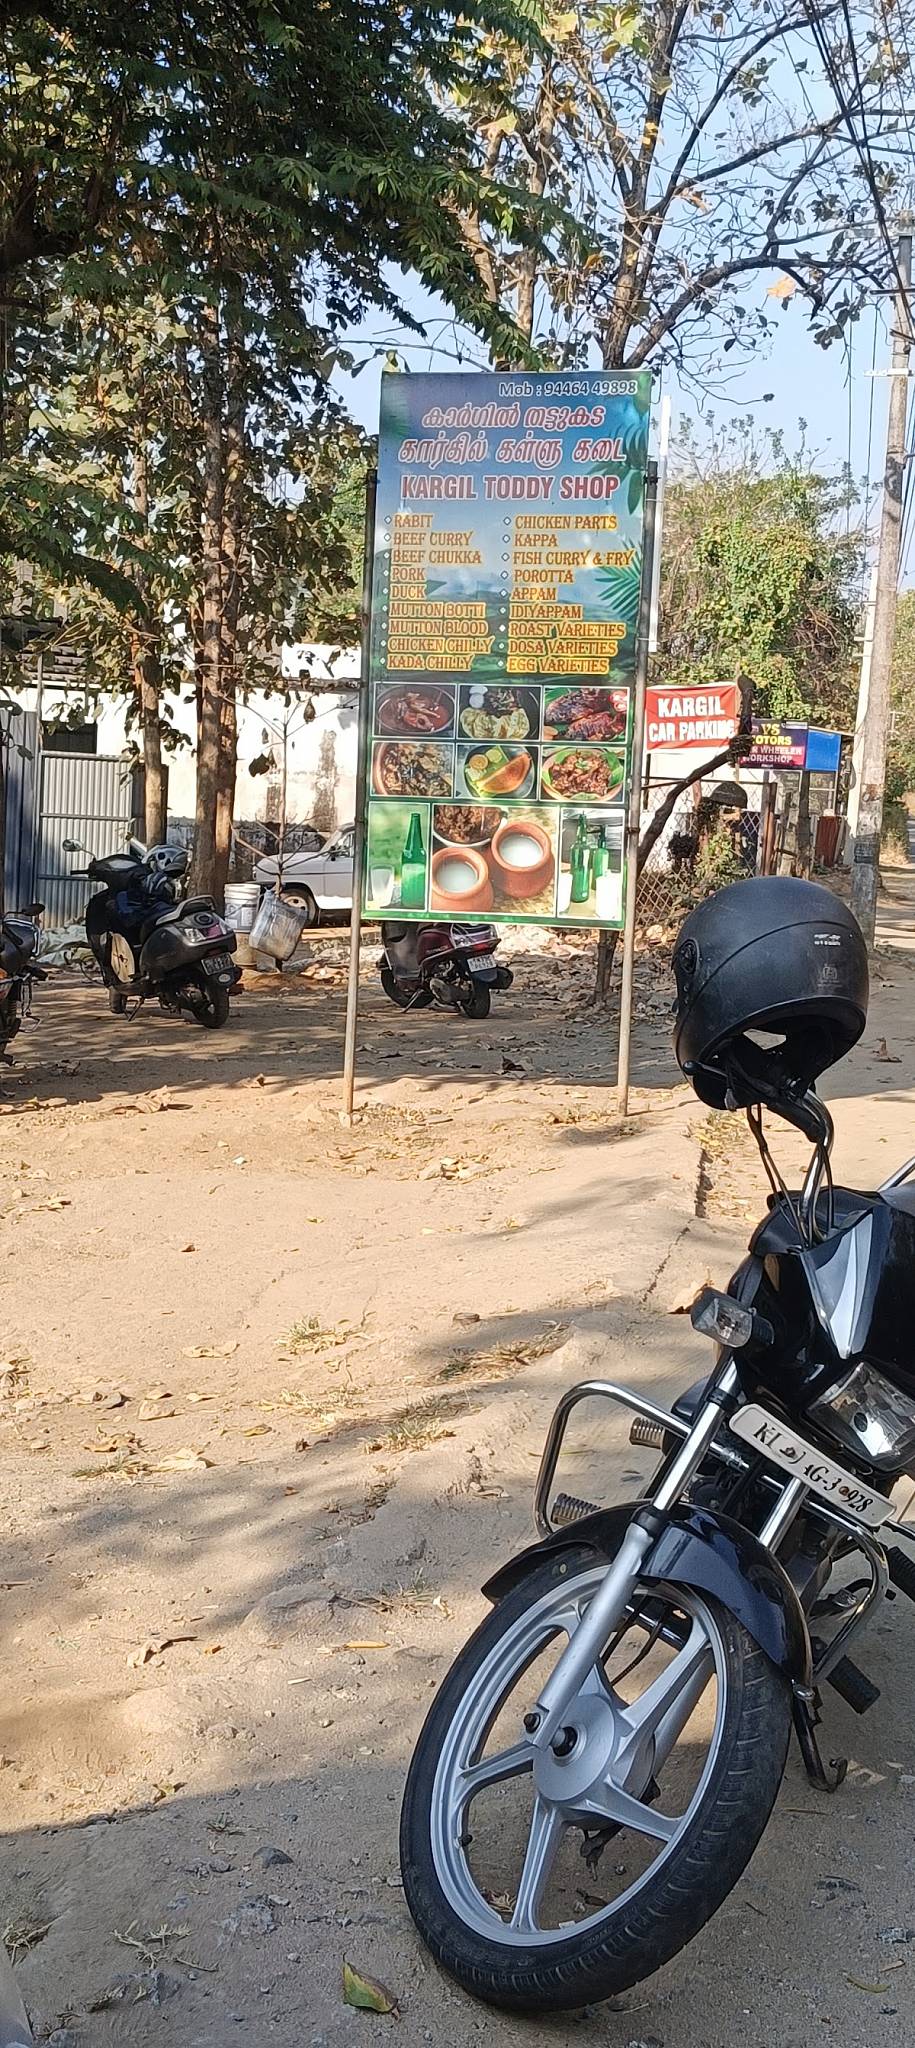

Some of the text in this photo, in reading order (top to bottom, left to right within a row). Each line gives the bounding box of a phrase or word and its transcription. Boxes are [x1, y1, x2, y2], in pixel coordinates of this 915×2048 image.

[500, 382, 532, 396] Mob
[544, 382, 588, 396] 94464
[591, 381, 637, 395] 49898
[402, 474, 619, 500] KARGIL TODDY SHOP
[394, 514, 433, 528] RABIT
[515, 515, 618, 530] CHICKEN PARTS
[393, 531, 473, 547] BEEF CURRY
[514, 533, 558, 547] KAPPA
[393, 550, 482, 565] BEEF CHUKKA
[513, 550, 635, 566] FISH CURRY & FRY
[392, 567, 426, 581] PORK
[514, 569, 574, 583] POROTTA
[391, 584, 426, 599] DUCK
[511, 588, 556, 601] APPAM
[390, 602, 485, 618] MUTTON BOTTI
[510, 604, 582, 619] IDIYAPPAM
[389, 620, 488, 635] MUTTON BLOOD
[509, 623, 626, 638] ROAST VARIETIES
[389, 637, 494, 653] CHICKEN CHILLY
[508, 640, 618, 655] DOSA VARIETIES
[388, 654, 473, 670] KADA CHILLY
[507, 656, 609, 674] EGG VARIETIES
[658, 696, 725, 717] KARGIL
[649, 720, 735, 742] CAR PARKING
